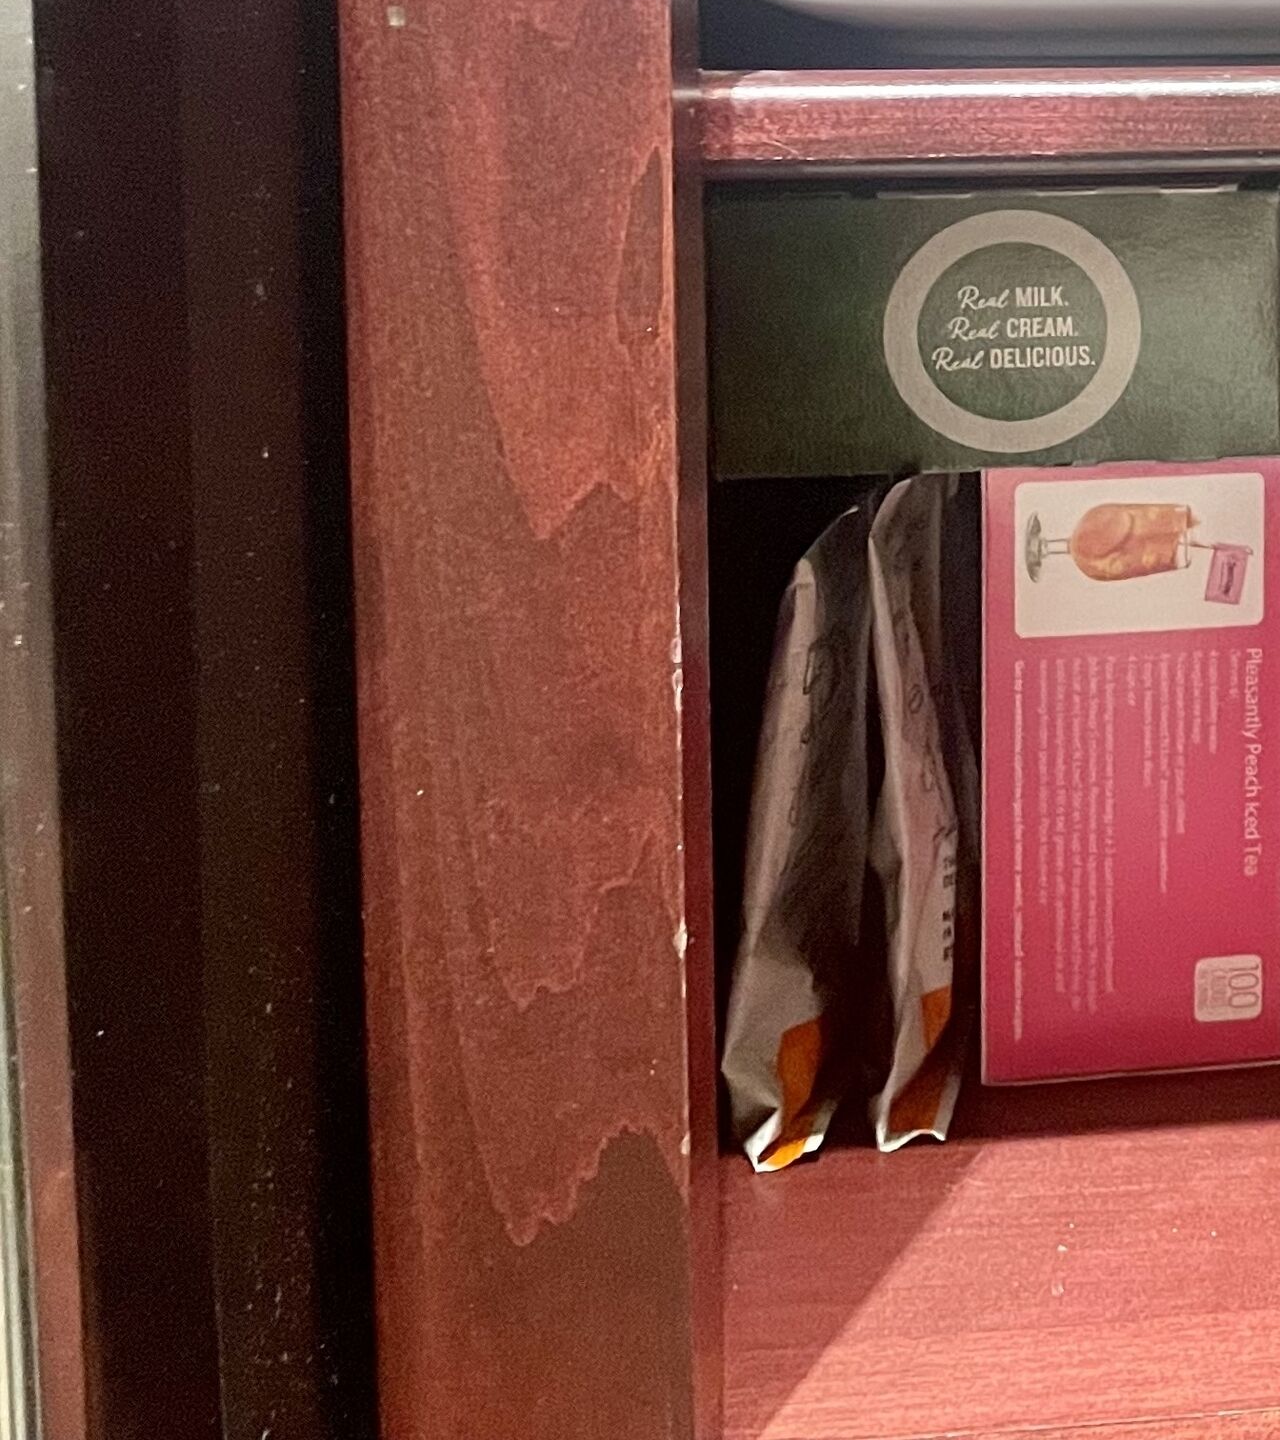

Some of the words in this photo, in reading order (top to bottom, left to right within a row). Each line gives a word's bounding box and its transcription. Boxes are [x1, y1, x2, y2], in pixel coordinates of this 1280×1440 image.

[958, 286, 1009, 310] Real
[1015, 286, 1069, 307] MILK.
[949, 317, 1000, 341] Real
[1007, 316, 1078, 338] CREAM.
[932, 347, 984, 371] Real
[990, 345, 1096, 369] DELICIOUS.
[1242, 648, 1262, 740] Pleasantly
[1244, 743, 1262, 798] Peach
[1244, 802, 1261, 840] Iced
[1244, 843, 1262, 877] Tea
[1228, 964, 1260, 1009] 100
